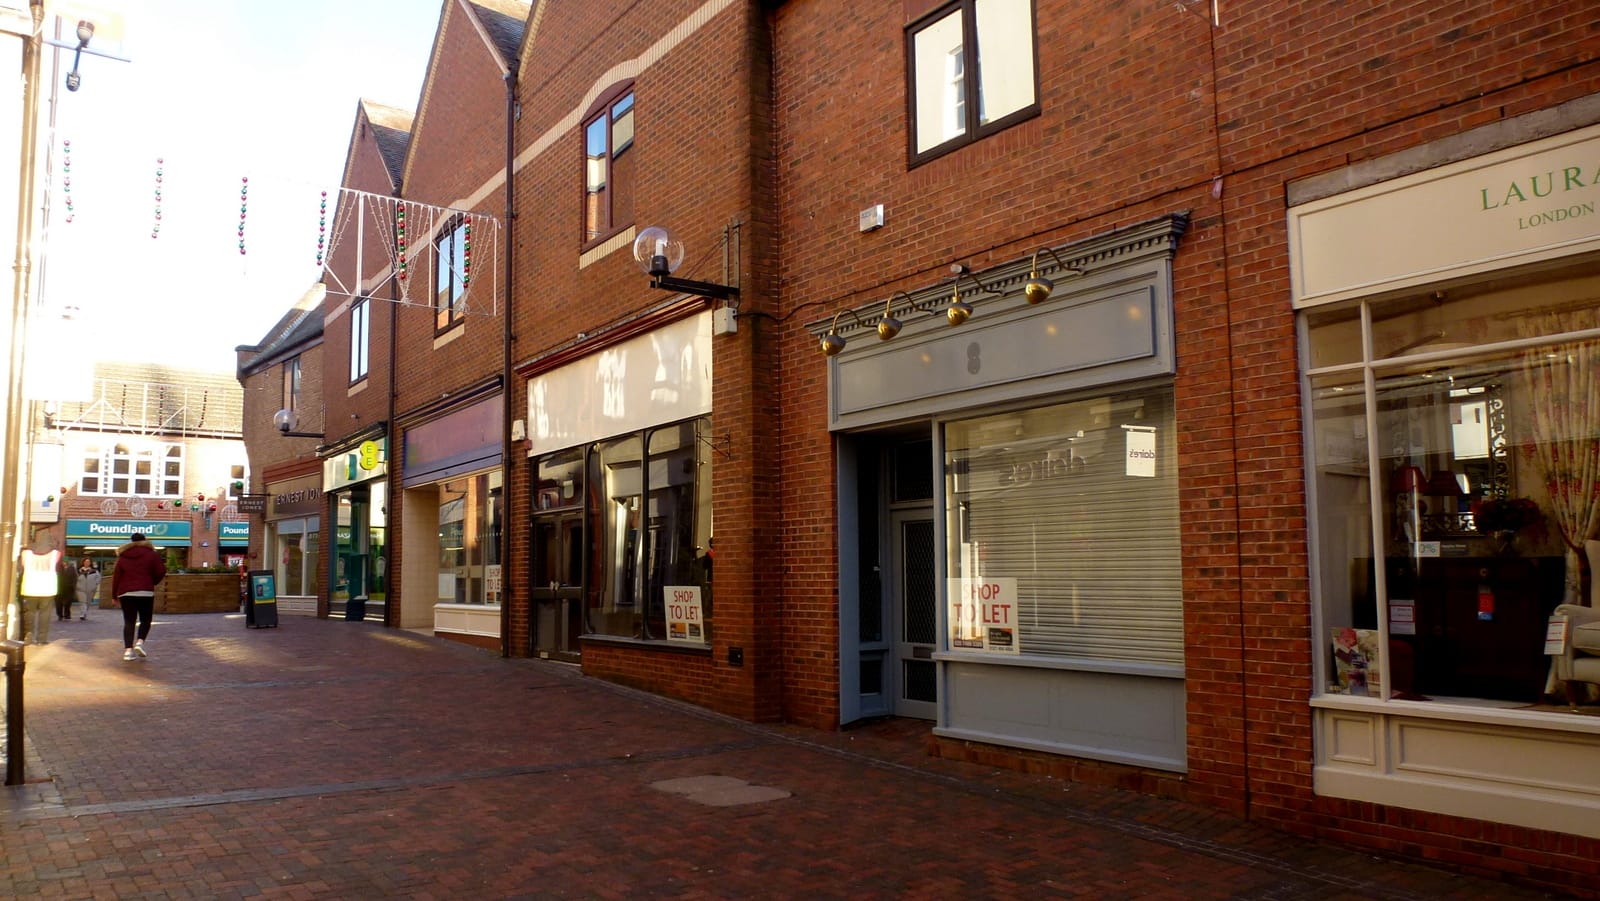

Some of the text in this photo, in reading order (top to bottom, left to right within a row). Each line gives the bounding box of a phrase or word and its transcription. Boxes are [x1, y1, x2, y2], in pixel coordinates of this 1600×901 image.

[1519, 201, 1595, 230] LONDON
[276, 490, 304, 505] ERNEST
[89, 522, 154, 534] Poundland
[223, 526, 249, 535] Pound
[674, 590, 693, 603] SHOP
[669, 604, 700, 621] TO LET
[982, 603, 1012, 624] LET
